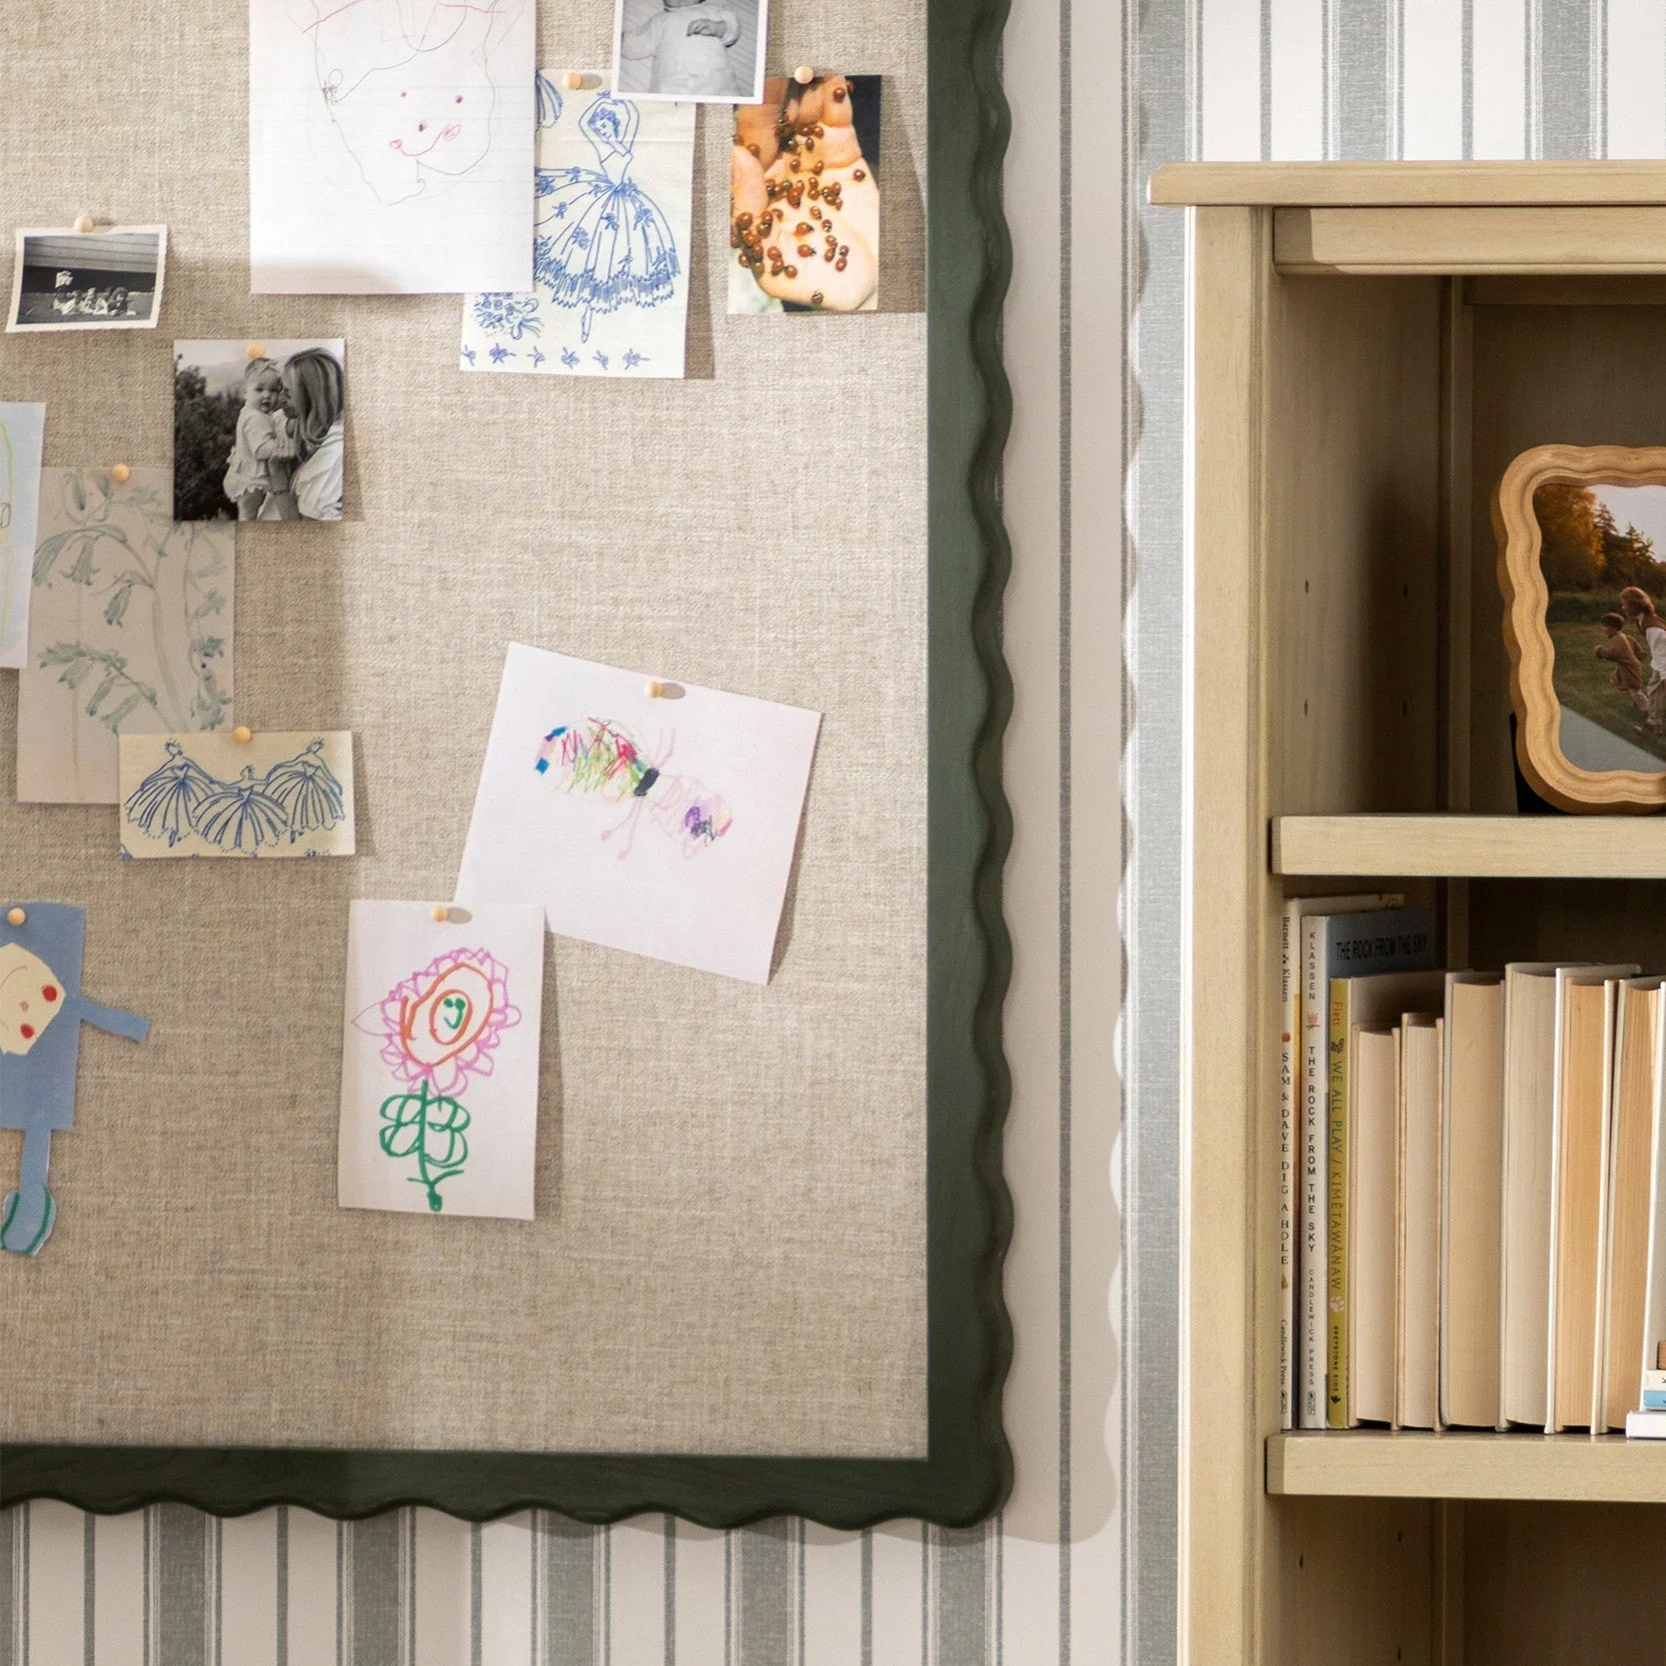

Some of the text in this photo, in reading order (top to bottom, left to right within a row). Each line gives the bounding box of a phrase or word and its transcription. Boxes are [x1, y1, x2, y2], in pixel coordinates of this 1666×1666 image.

[1308, 932, 1316, 1000] KLASSEN
[1282, 969, 1290, 1002] Klassen
[1332, 1001, 1343, 1026] Flett
[1281, 1053, 1290, 1085] SAM
[1332, 1060, 1343, 1083] WE
[1331, 1089, 1342, 1112] ALL
[1281, 1109, 1290, 1153] DAVE
[1332, 1120, 1343, 1154] PLAY
[1308, 1135, 1316, 1175] FROM
[1281, 1162, 1290, 1195] DIG
[1281, 1203, 1289, 1212] A
[1281, 1220, 1289, 1265] HOLE
